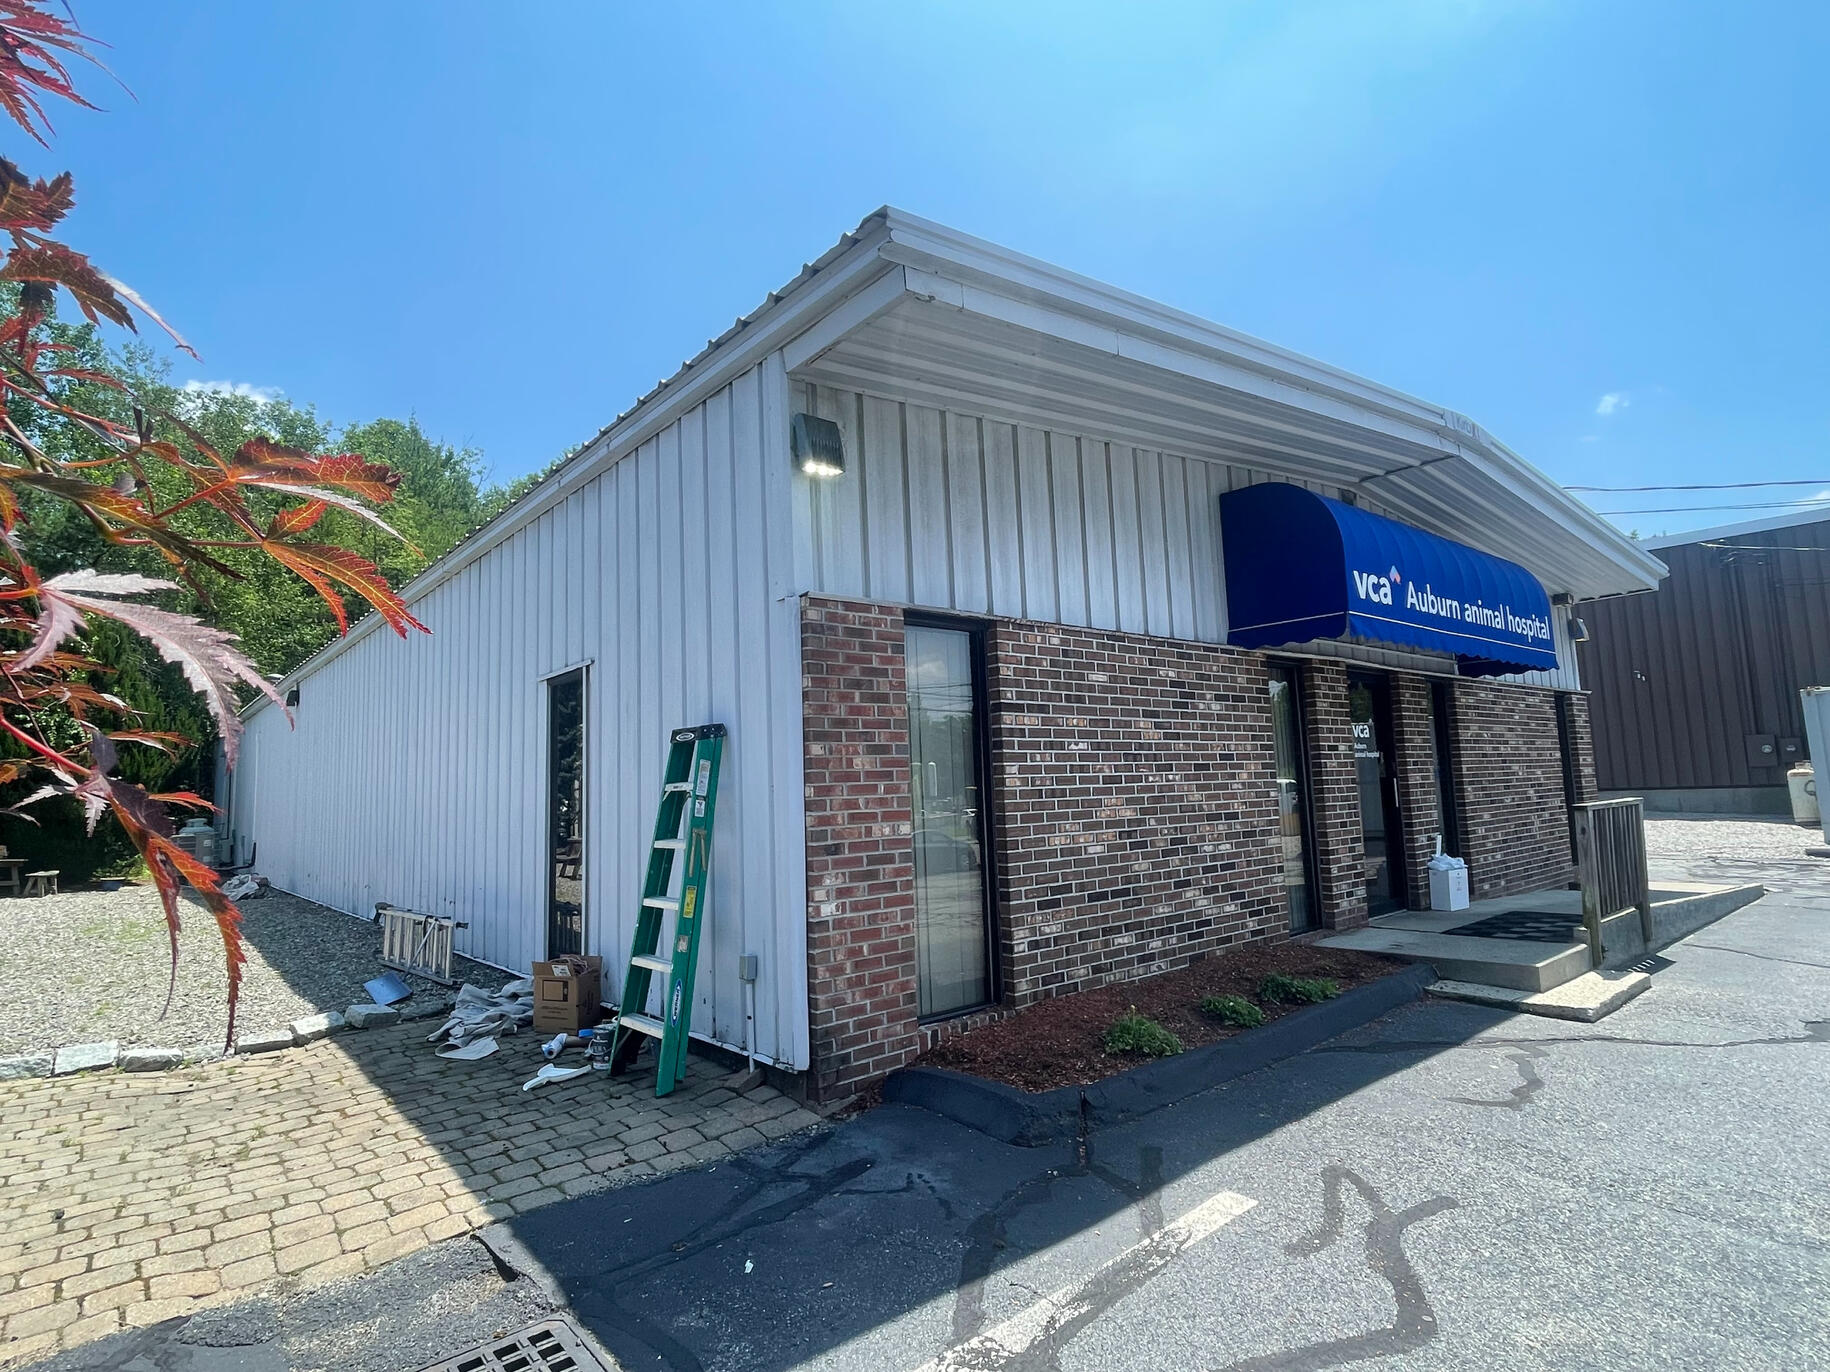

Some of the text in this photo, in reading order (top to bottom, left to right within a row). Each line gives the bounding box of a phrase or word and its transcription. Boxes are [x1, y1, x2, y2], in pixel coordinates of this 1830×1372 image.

[1353, 570, 1392, 605] vca
[1407, 581, 1550, 643] Auburn animal hospital
[1352, 724, 1370, 738] vca
